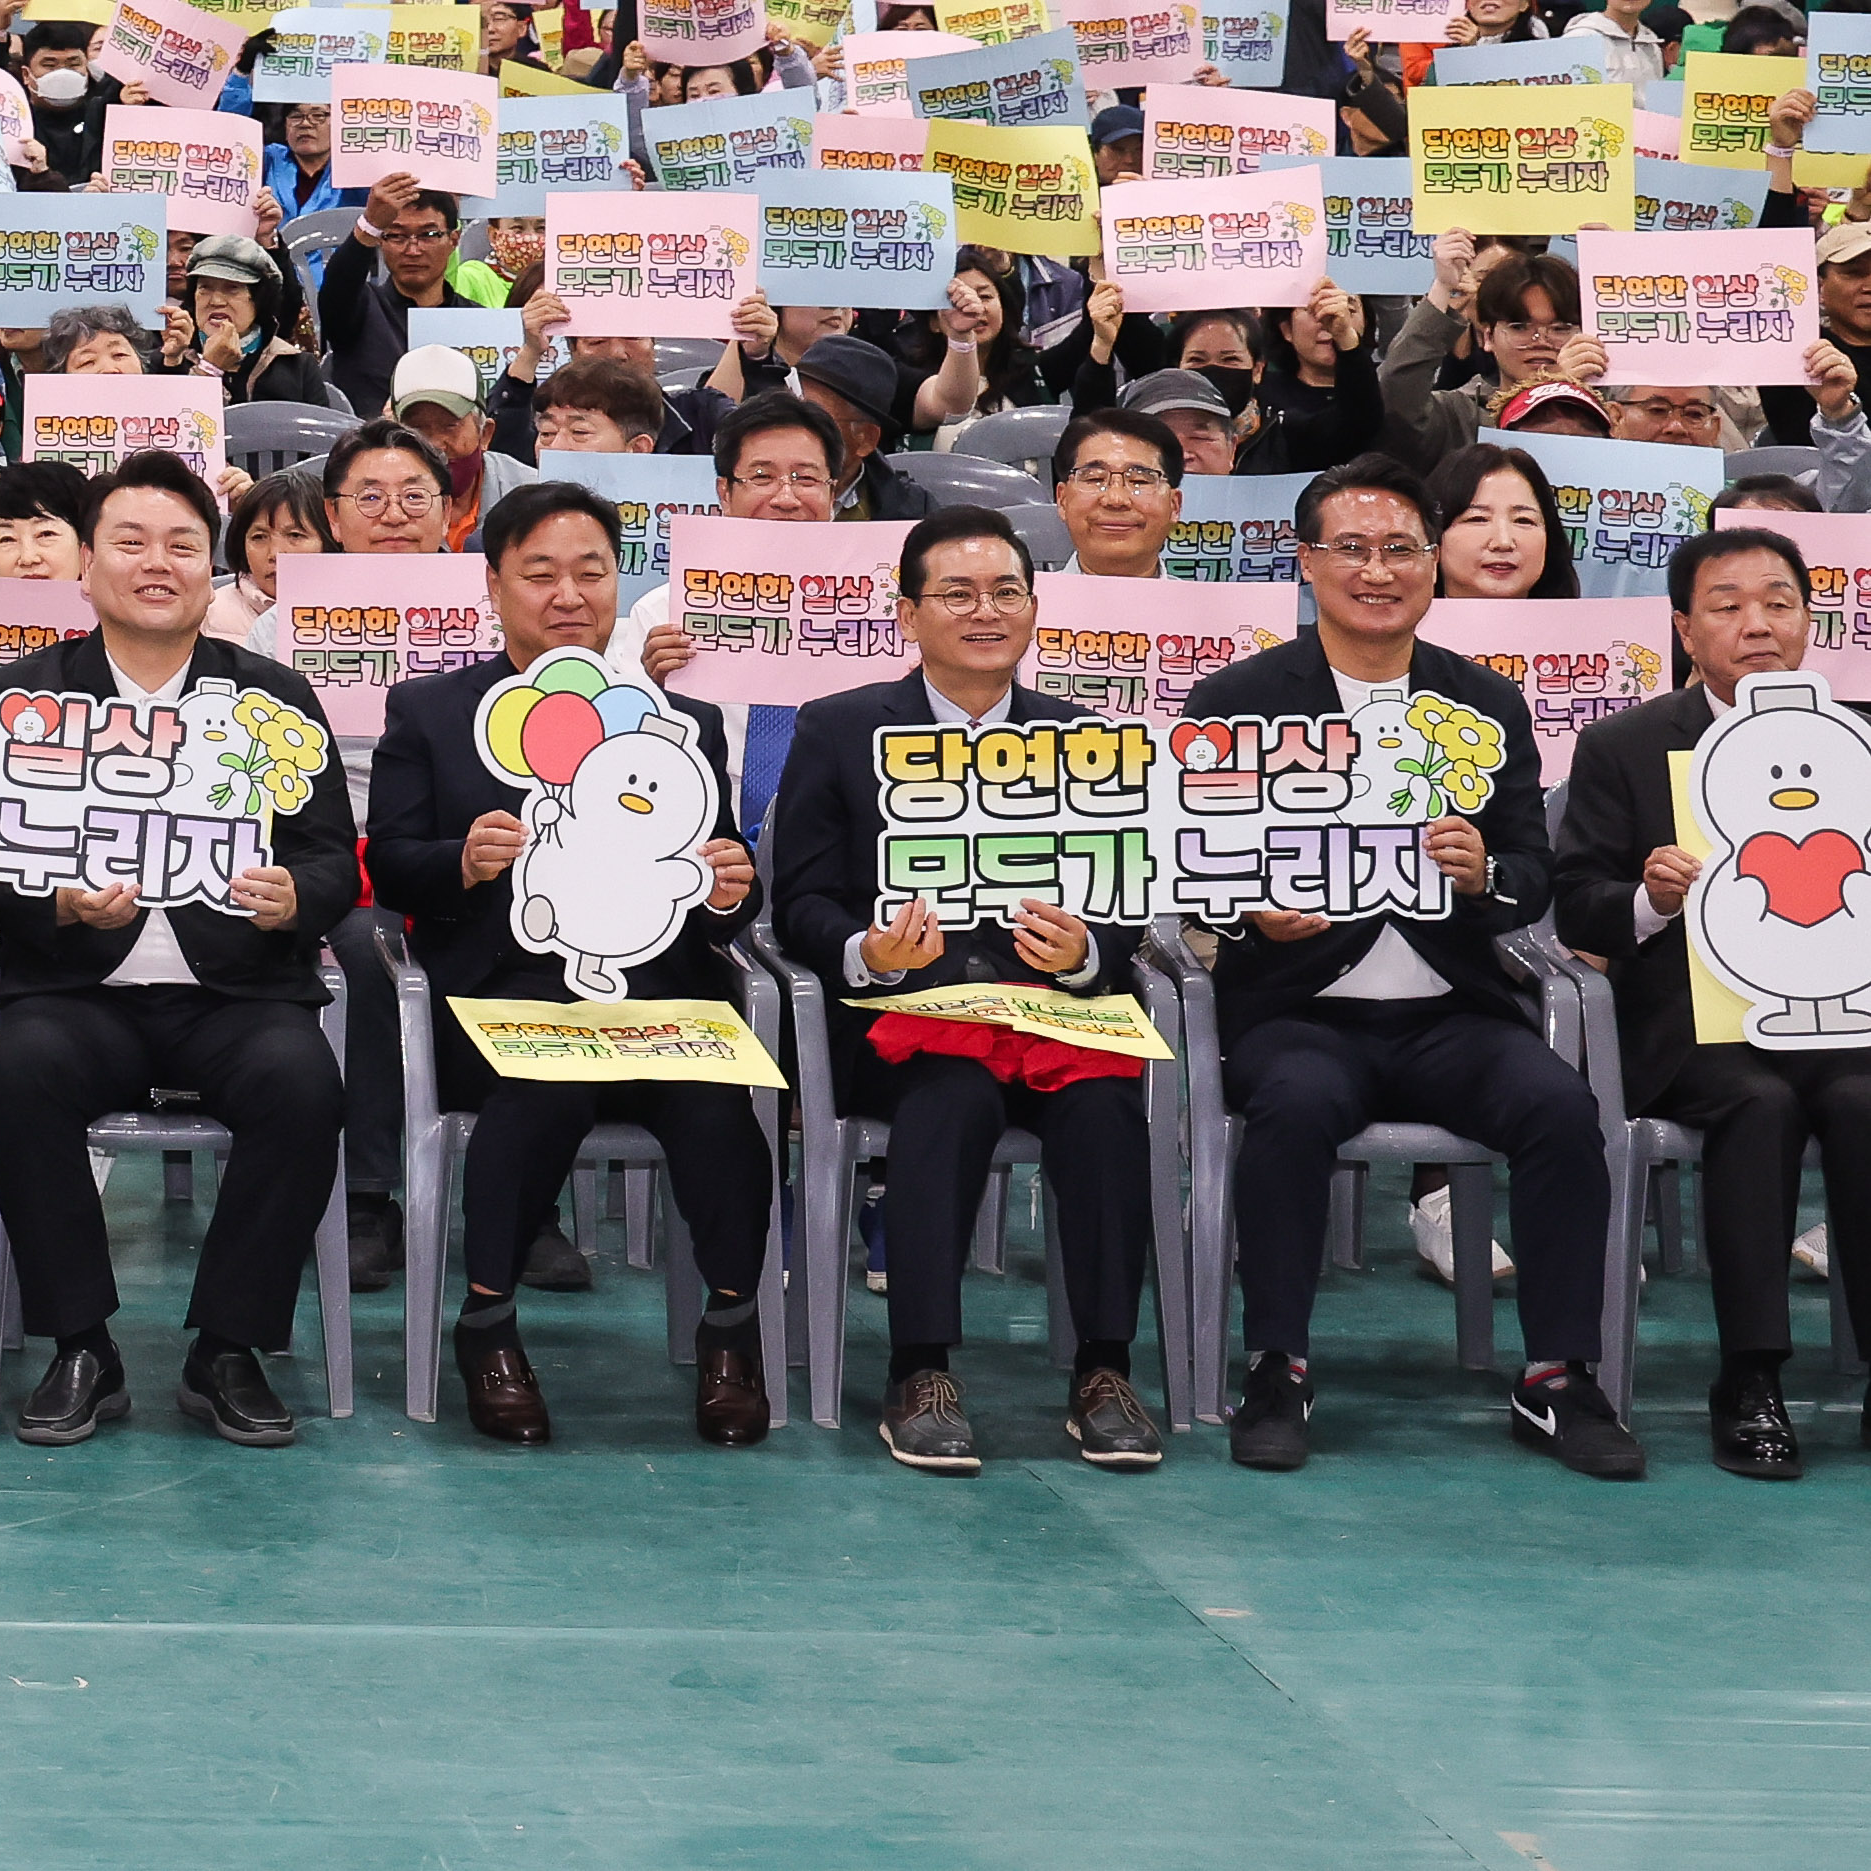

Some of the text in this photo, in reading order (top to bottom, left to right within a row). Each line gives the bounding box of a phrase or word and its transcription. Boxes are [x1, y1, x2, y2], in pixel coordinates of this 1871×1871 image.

[341, 98, 462, 129] 당연한 일상
[113, 141, 233, 172] 당연한 일상
[340, 126, 481, 161] 모두가 누리자
[1422, 127, 1578, 159] 당연한 일상
[110, 168, 248, 206] 모두가 누리자
[1424, 162, 1609, 193] 모두가 누리자
[765, 207, 907, 236] 당연한 일상
[1114, 213, 1270, 242] 당연한 일상
[65, 230, 119, 261] 일상
[557, 233, 706, 263] 당연한 일상
[763, 239, 934, 270] 모두가 누리자
[1116, 240, 1301, 274] 모두가 누리자
[65, 264, 144, 292] 누리자
[557, 268, 734, 298] 모두가 누리자
[1594, 275, 1757, 308] 당연한 일상
[1596, 311, 1794, 344] 모두가 누리자
[683, 570, 871, 616] 당연한 일상
[682, 616, 793, 654] 모두가
[880, 720, 1359, 822] 당연한 일상
[881, 824, 1449, 926] 모두가 누리자
